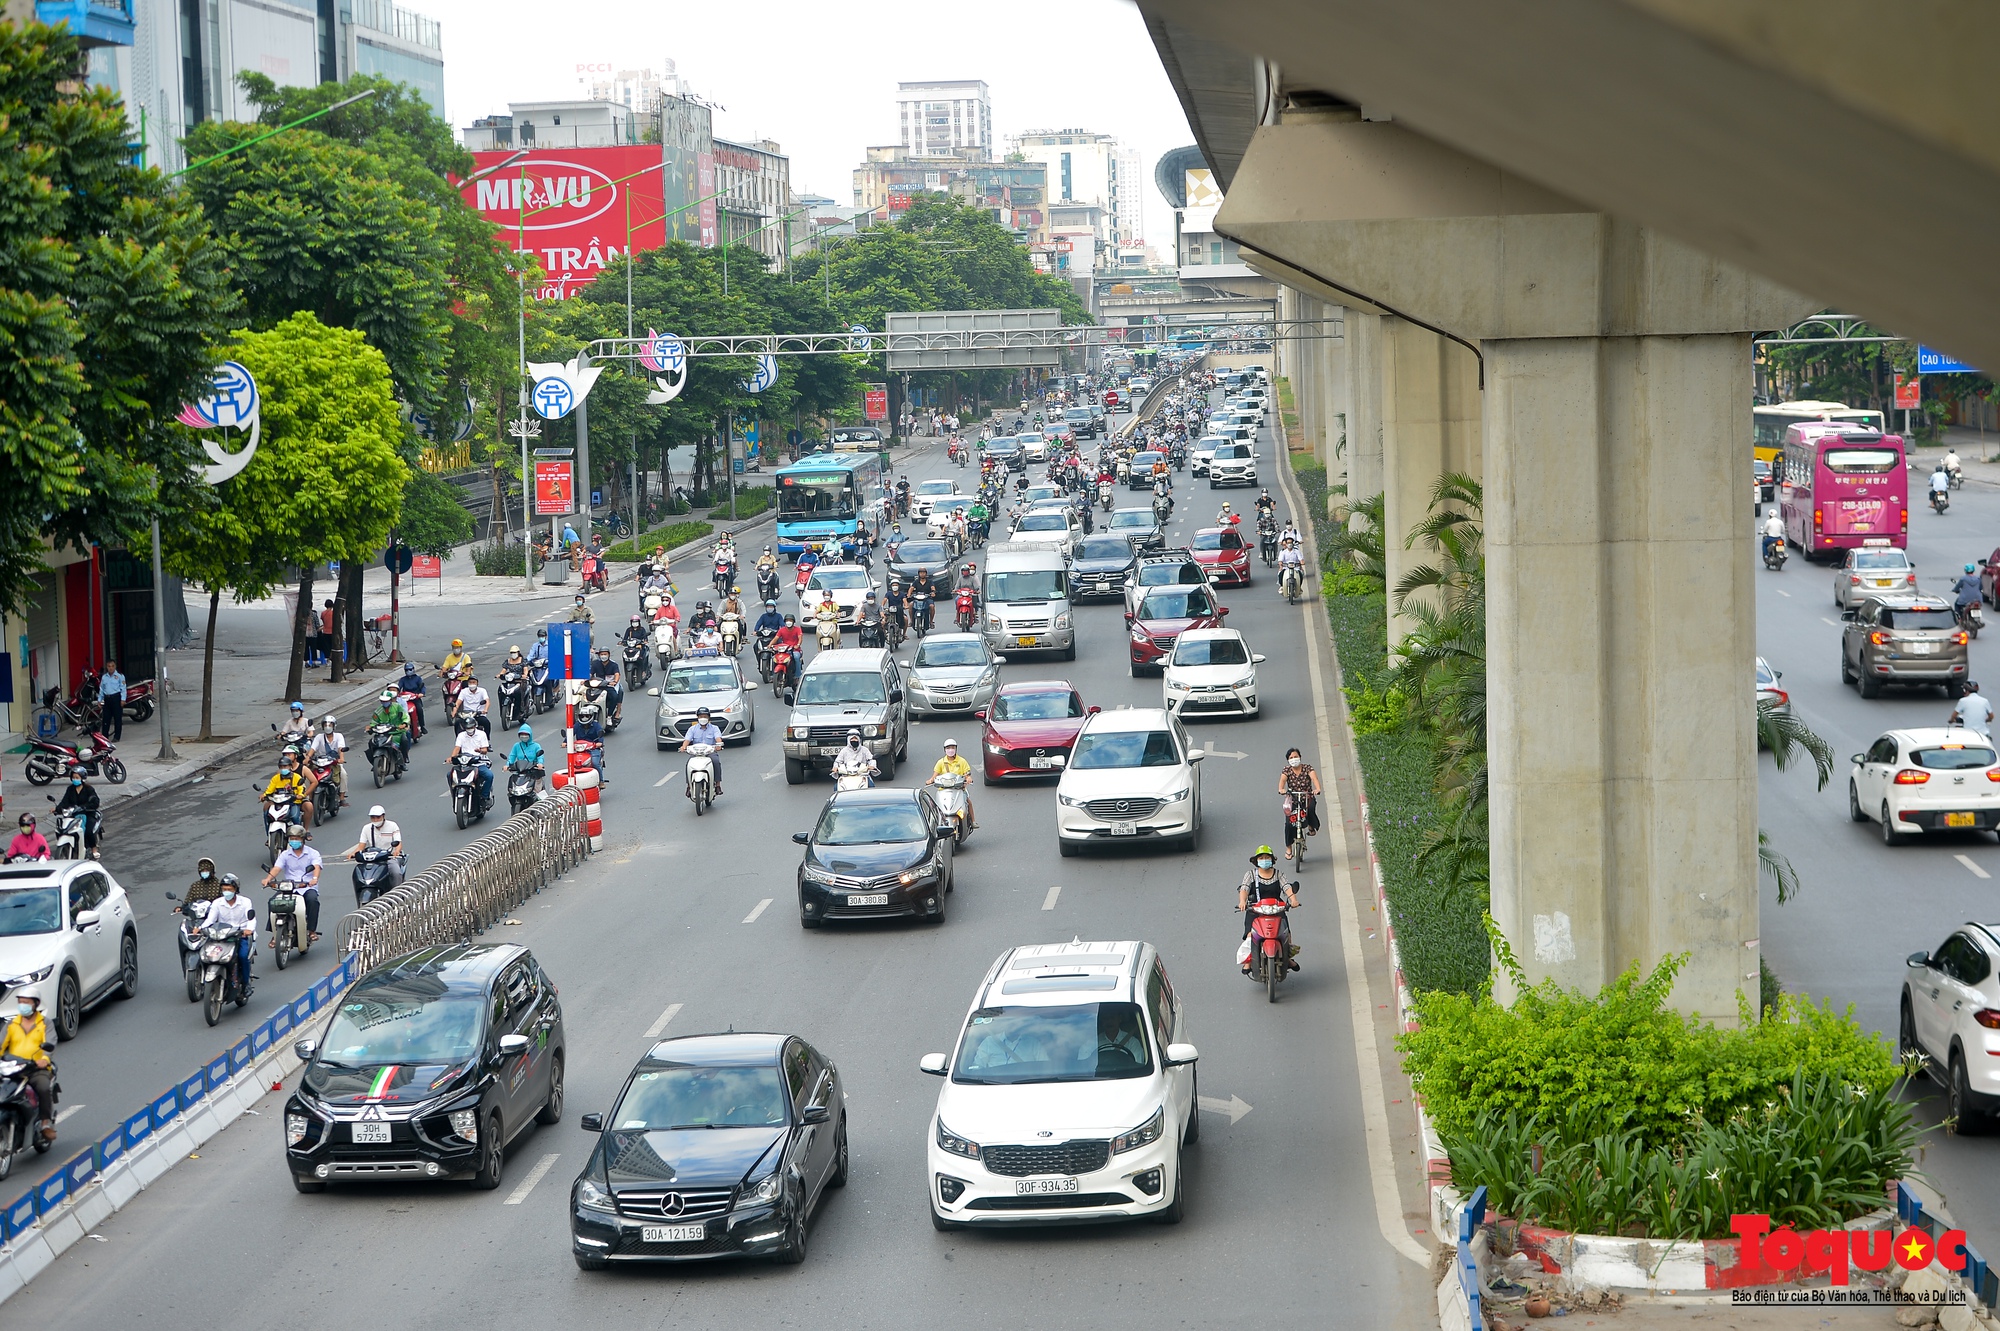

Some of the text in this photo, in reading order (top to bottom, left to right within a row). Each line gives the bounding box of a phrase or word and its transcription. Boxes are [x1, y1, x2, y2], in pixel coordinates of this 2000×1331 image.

[576, 63, 612, 73] PCC1
[1921, 354, 1938, 365] CAO
[784, 477, 793, 486] 02
[363, 1124, 380, 1133] 30H
[356, 1133, 388, 1142] 572.59
[1018, 1179, 1076, 1194] 30F-934.35
[644, 1227, 702, 1240] 30A-121.59
